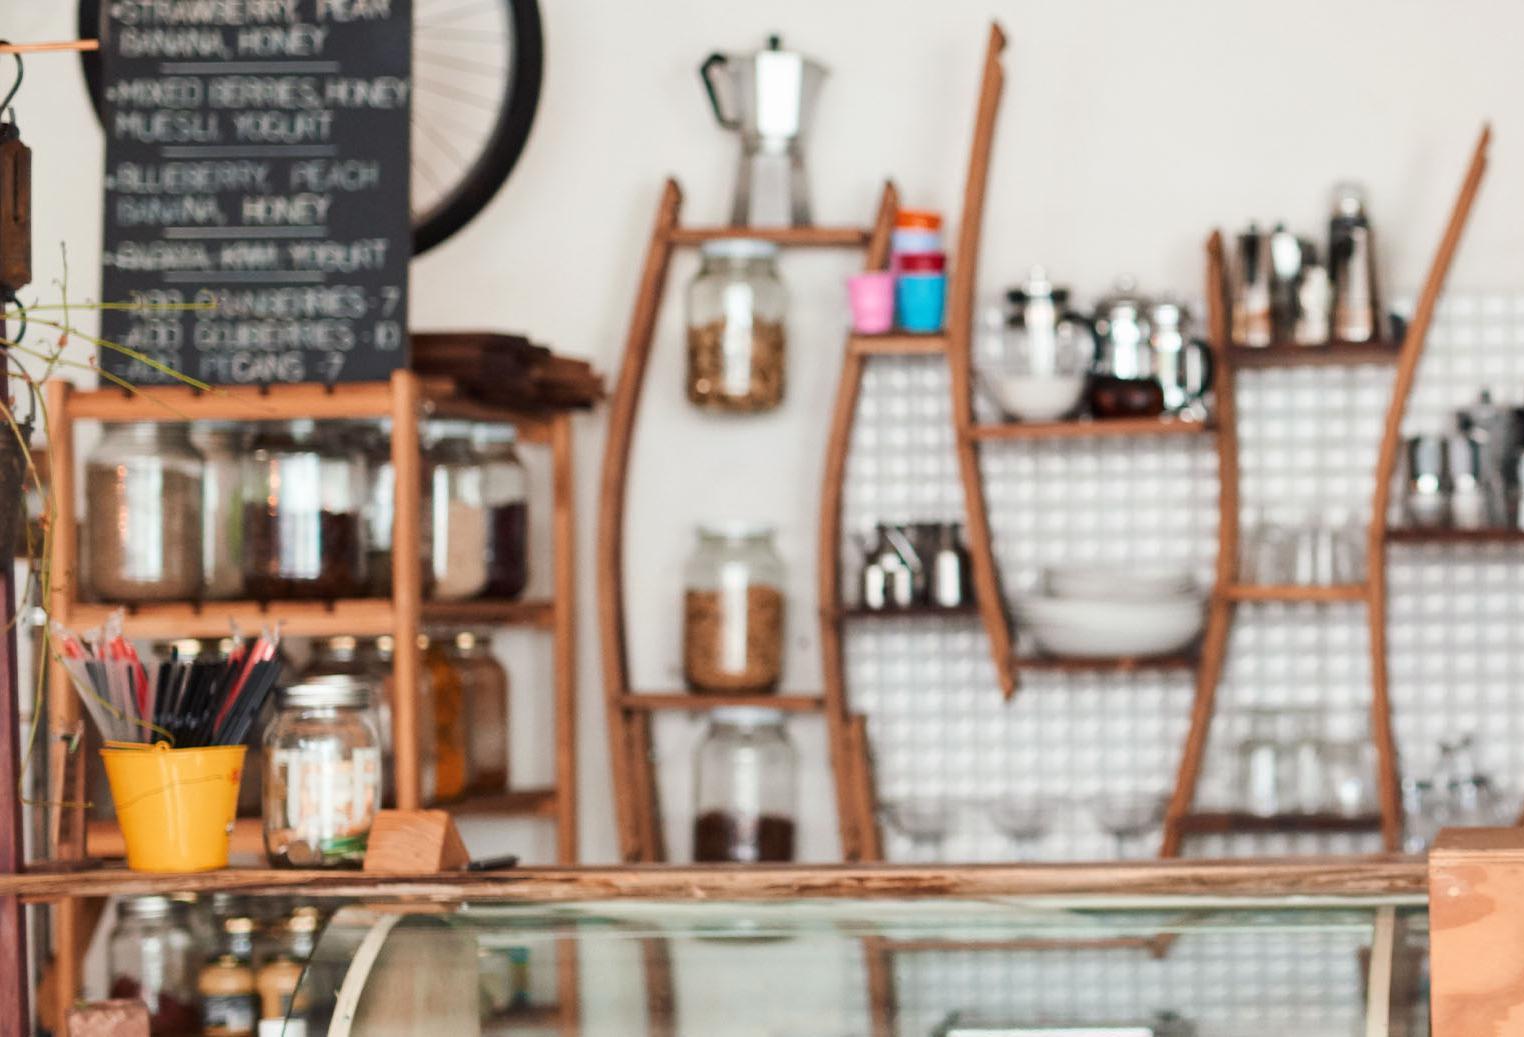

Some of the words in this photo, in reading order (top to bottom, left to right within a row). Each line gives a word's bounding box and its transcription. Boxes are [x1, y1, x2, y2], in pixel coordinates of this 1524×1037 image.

[237, 24, 328, 56] HONEY
[233, 109, 334, 143] YOGURT
[290, 160, 380, 192] PEACH
[241, 192, 333, 224] HONEY
[287, 238, 390, 272] YOGURT
